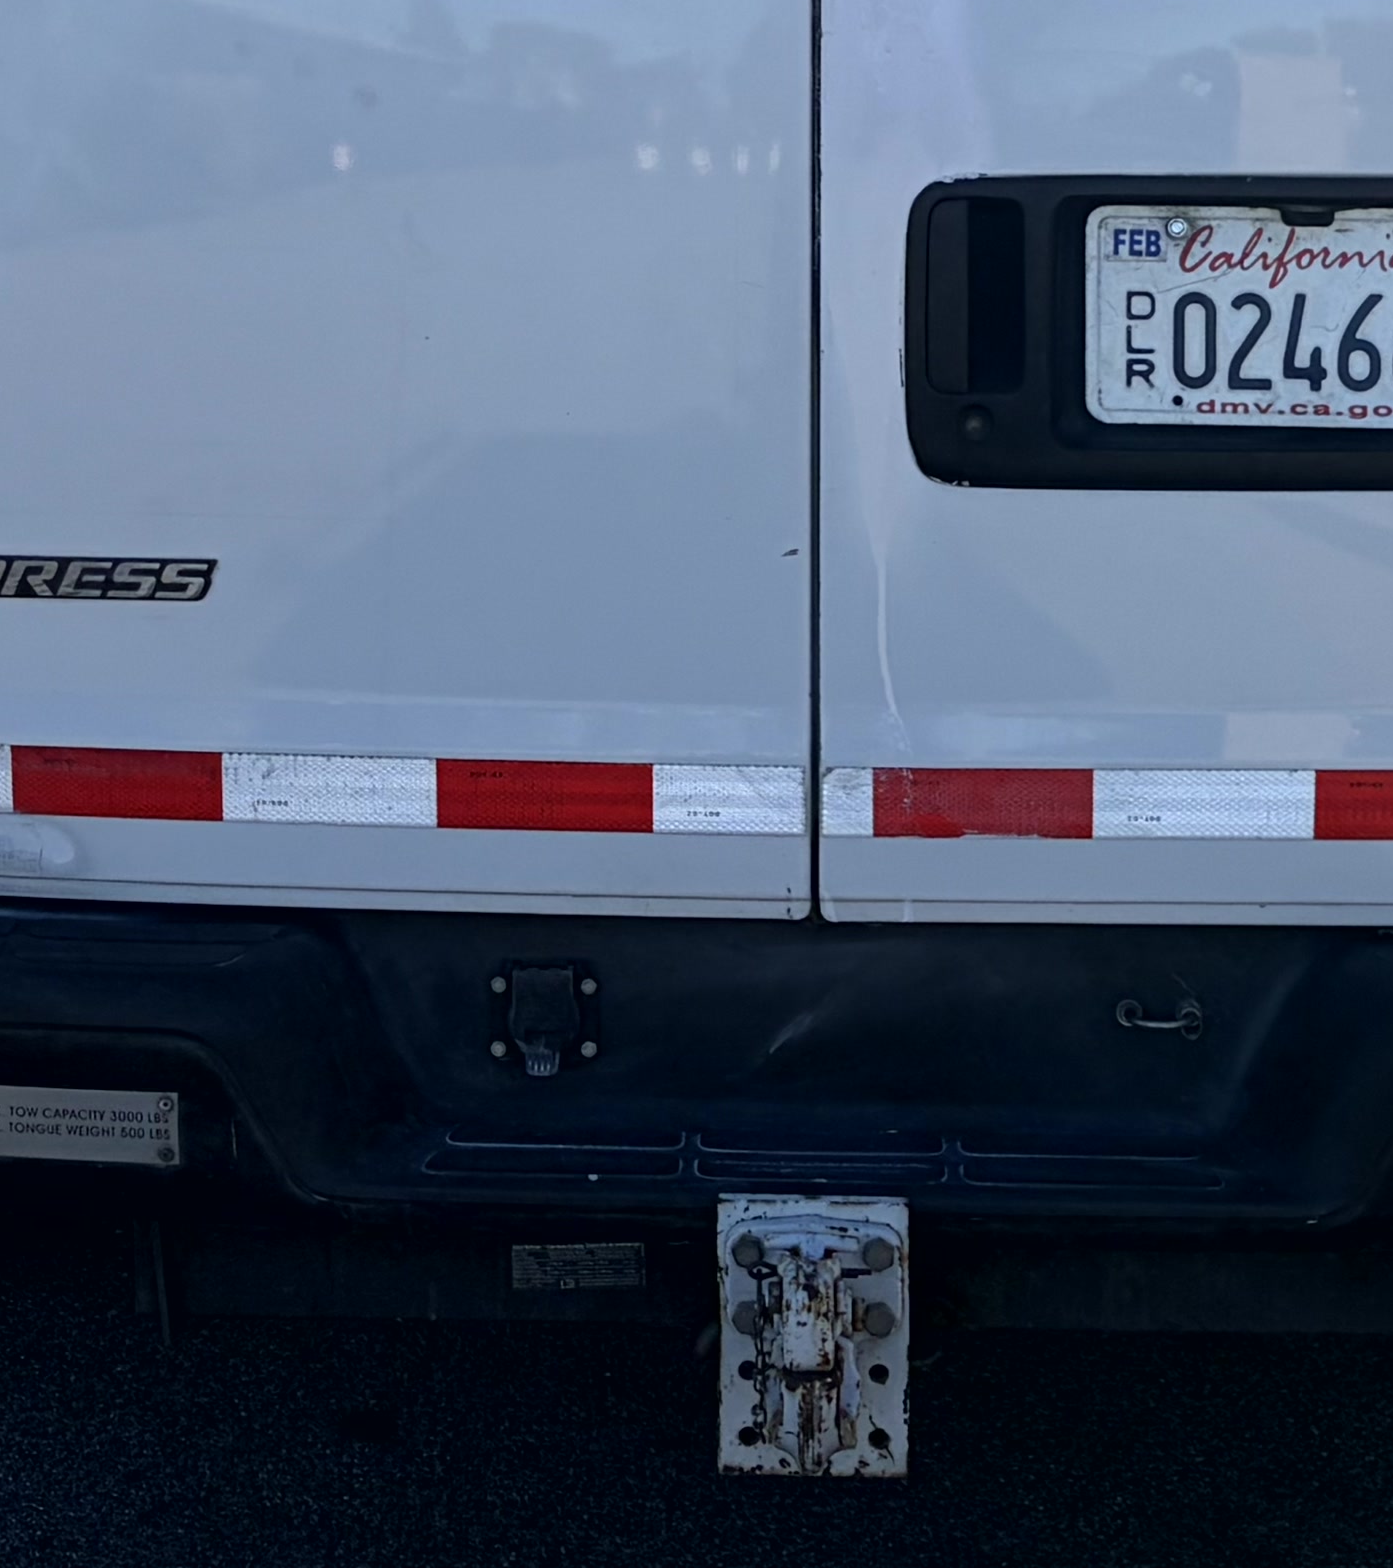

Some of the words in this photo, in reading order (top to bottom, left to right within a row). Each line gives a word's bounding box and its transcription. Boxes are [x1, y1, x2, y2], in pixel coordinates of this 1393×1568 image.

[1113, 228, 1162, 257] FEB
[9, 1106, 38, 1118] TOW
[42, 1107, 105, 1122] CAPACITY
[110, 1110, 144, 1123] 3000
[8, 1121, 62, 1136] TONGUE
[65, 1124, 116, 1137] WEIGHT
[120, 1126, 145, 1140] 500
[149, 1128, 171, 1141] LBS
